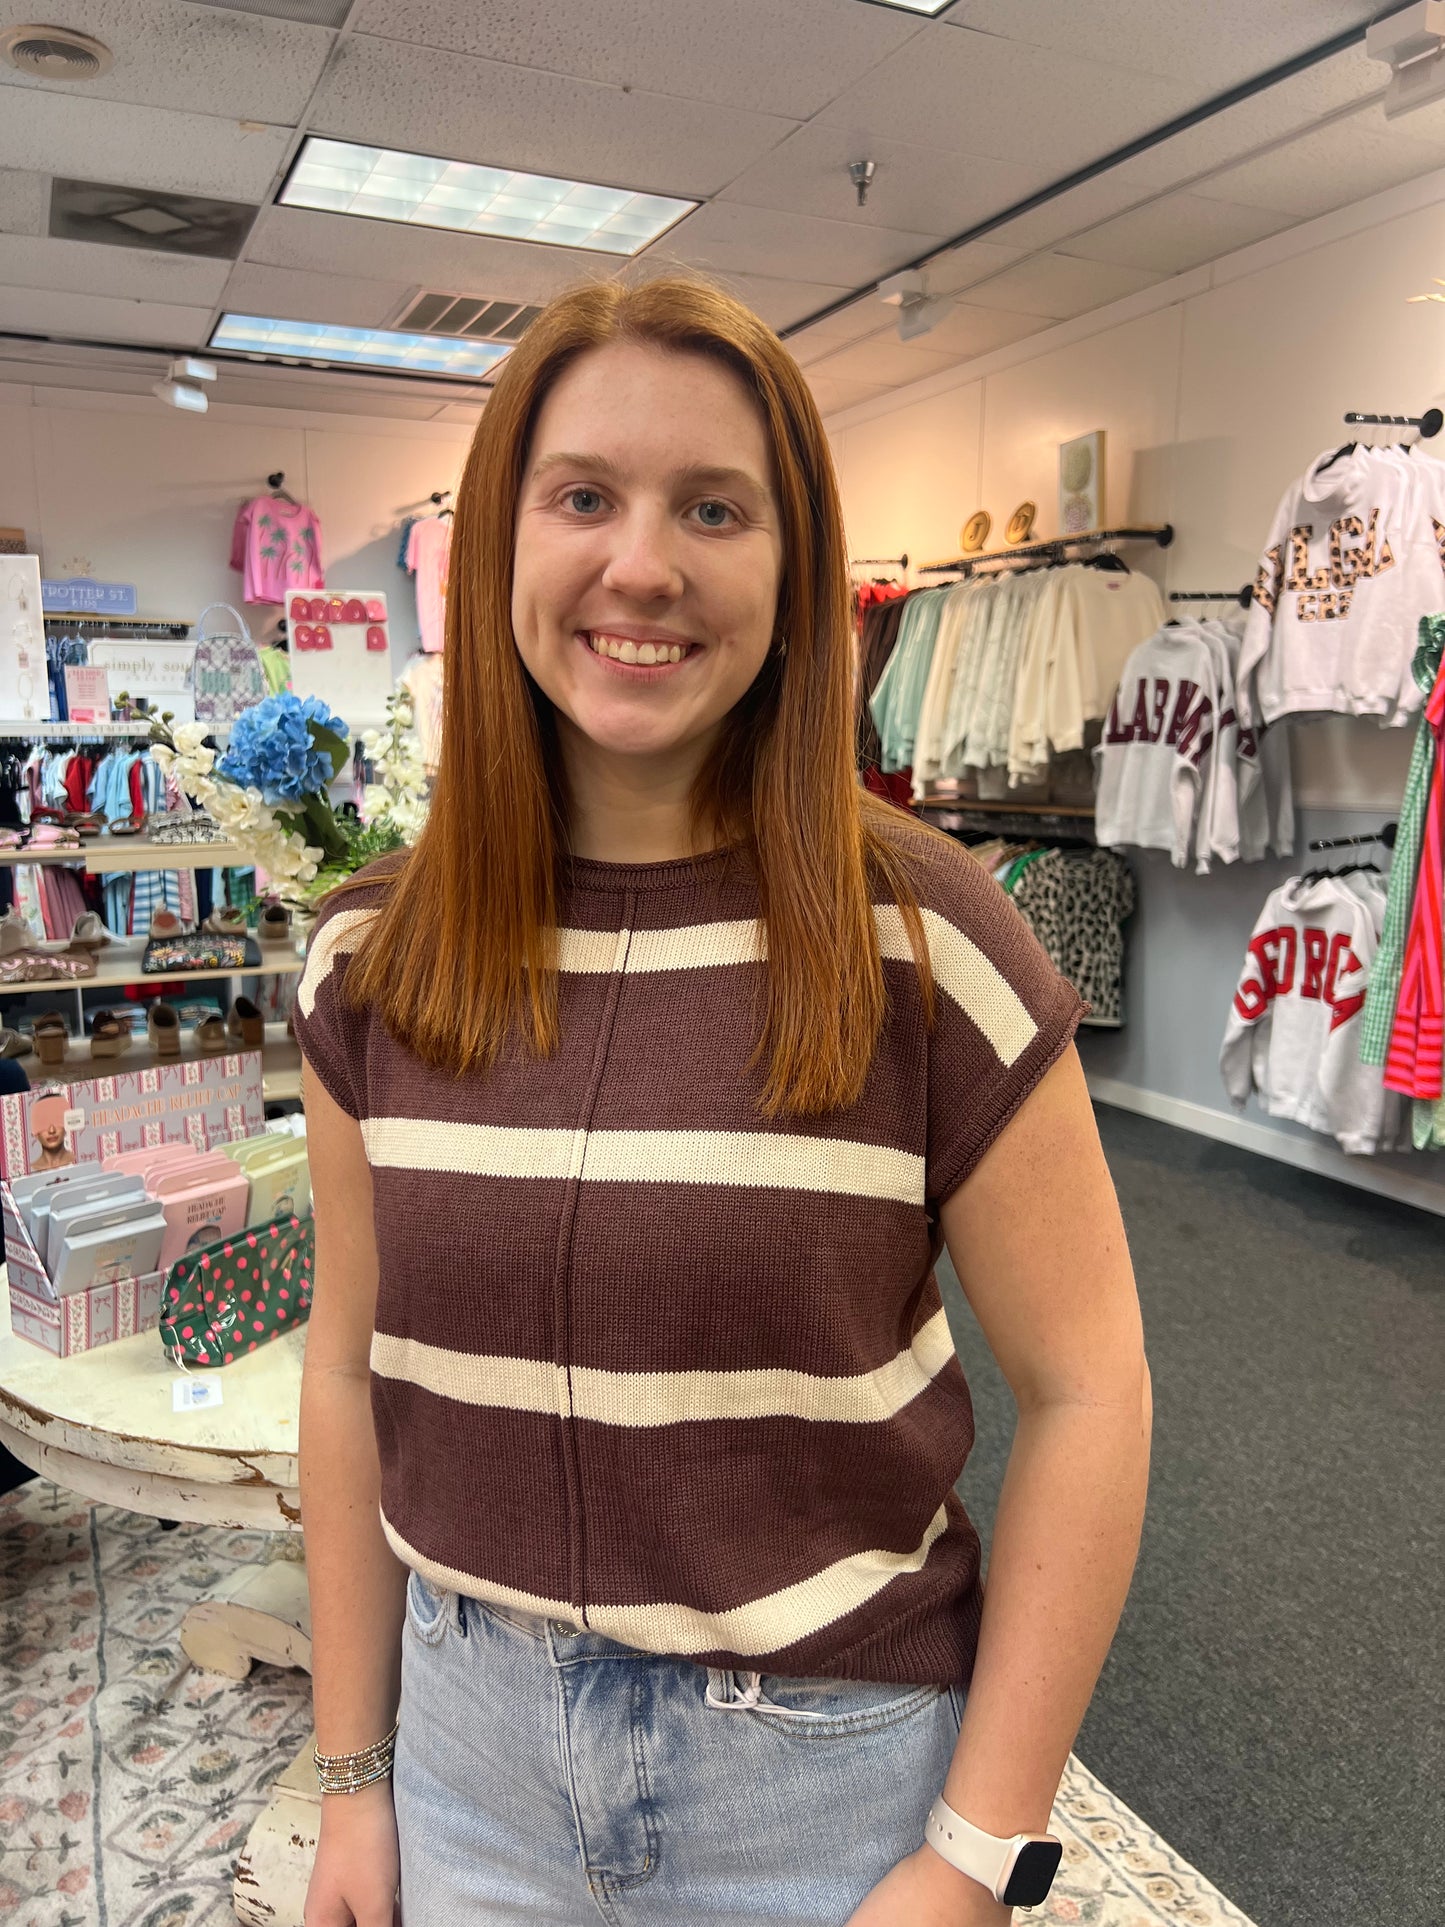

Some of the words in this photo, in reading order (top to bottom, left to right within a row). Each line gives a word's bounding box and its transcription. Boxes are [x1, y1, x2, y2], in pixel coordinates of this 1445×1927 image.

[105, 656, 153, 676] simply
[163, 661, 192, 672] sou
[91, 1102, 165, 1128] HEADACHE
[169, 1088, 212, 1113] RELIEF
[216, 1083, 242, 1101] CAP
